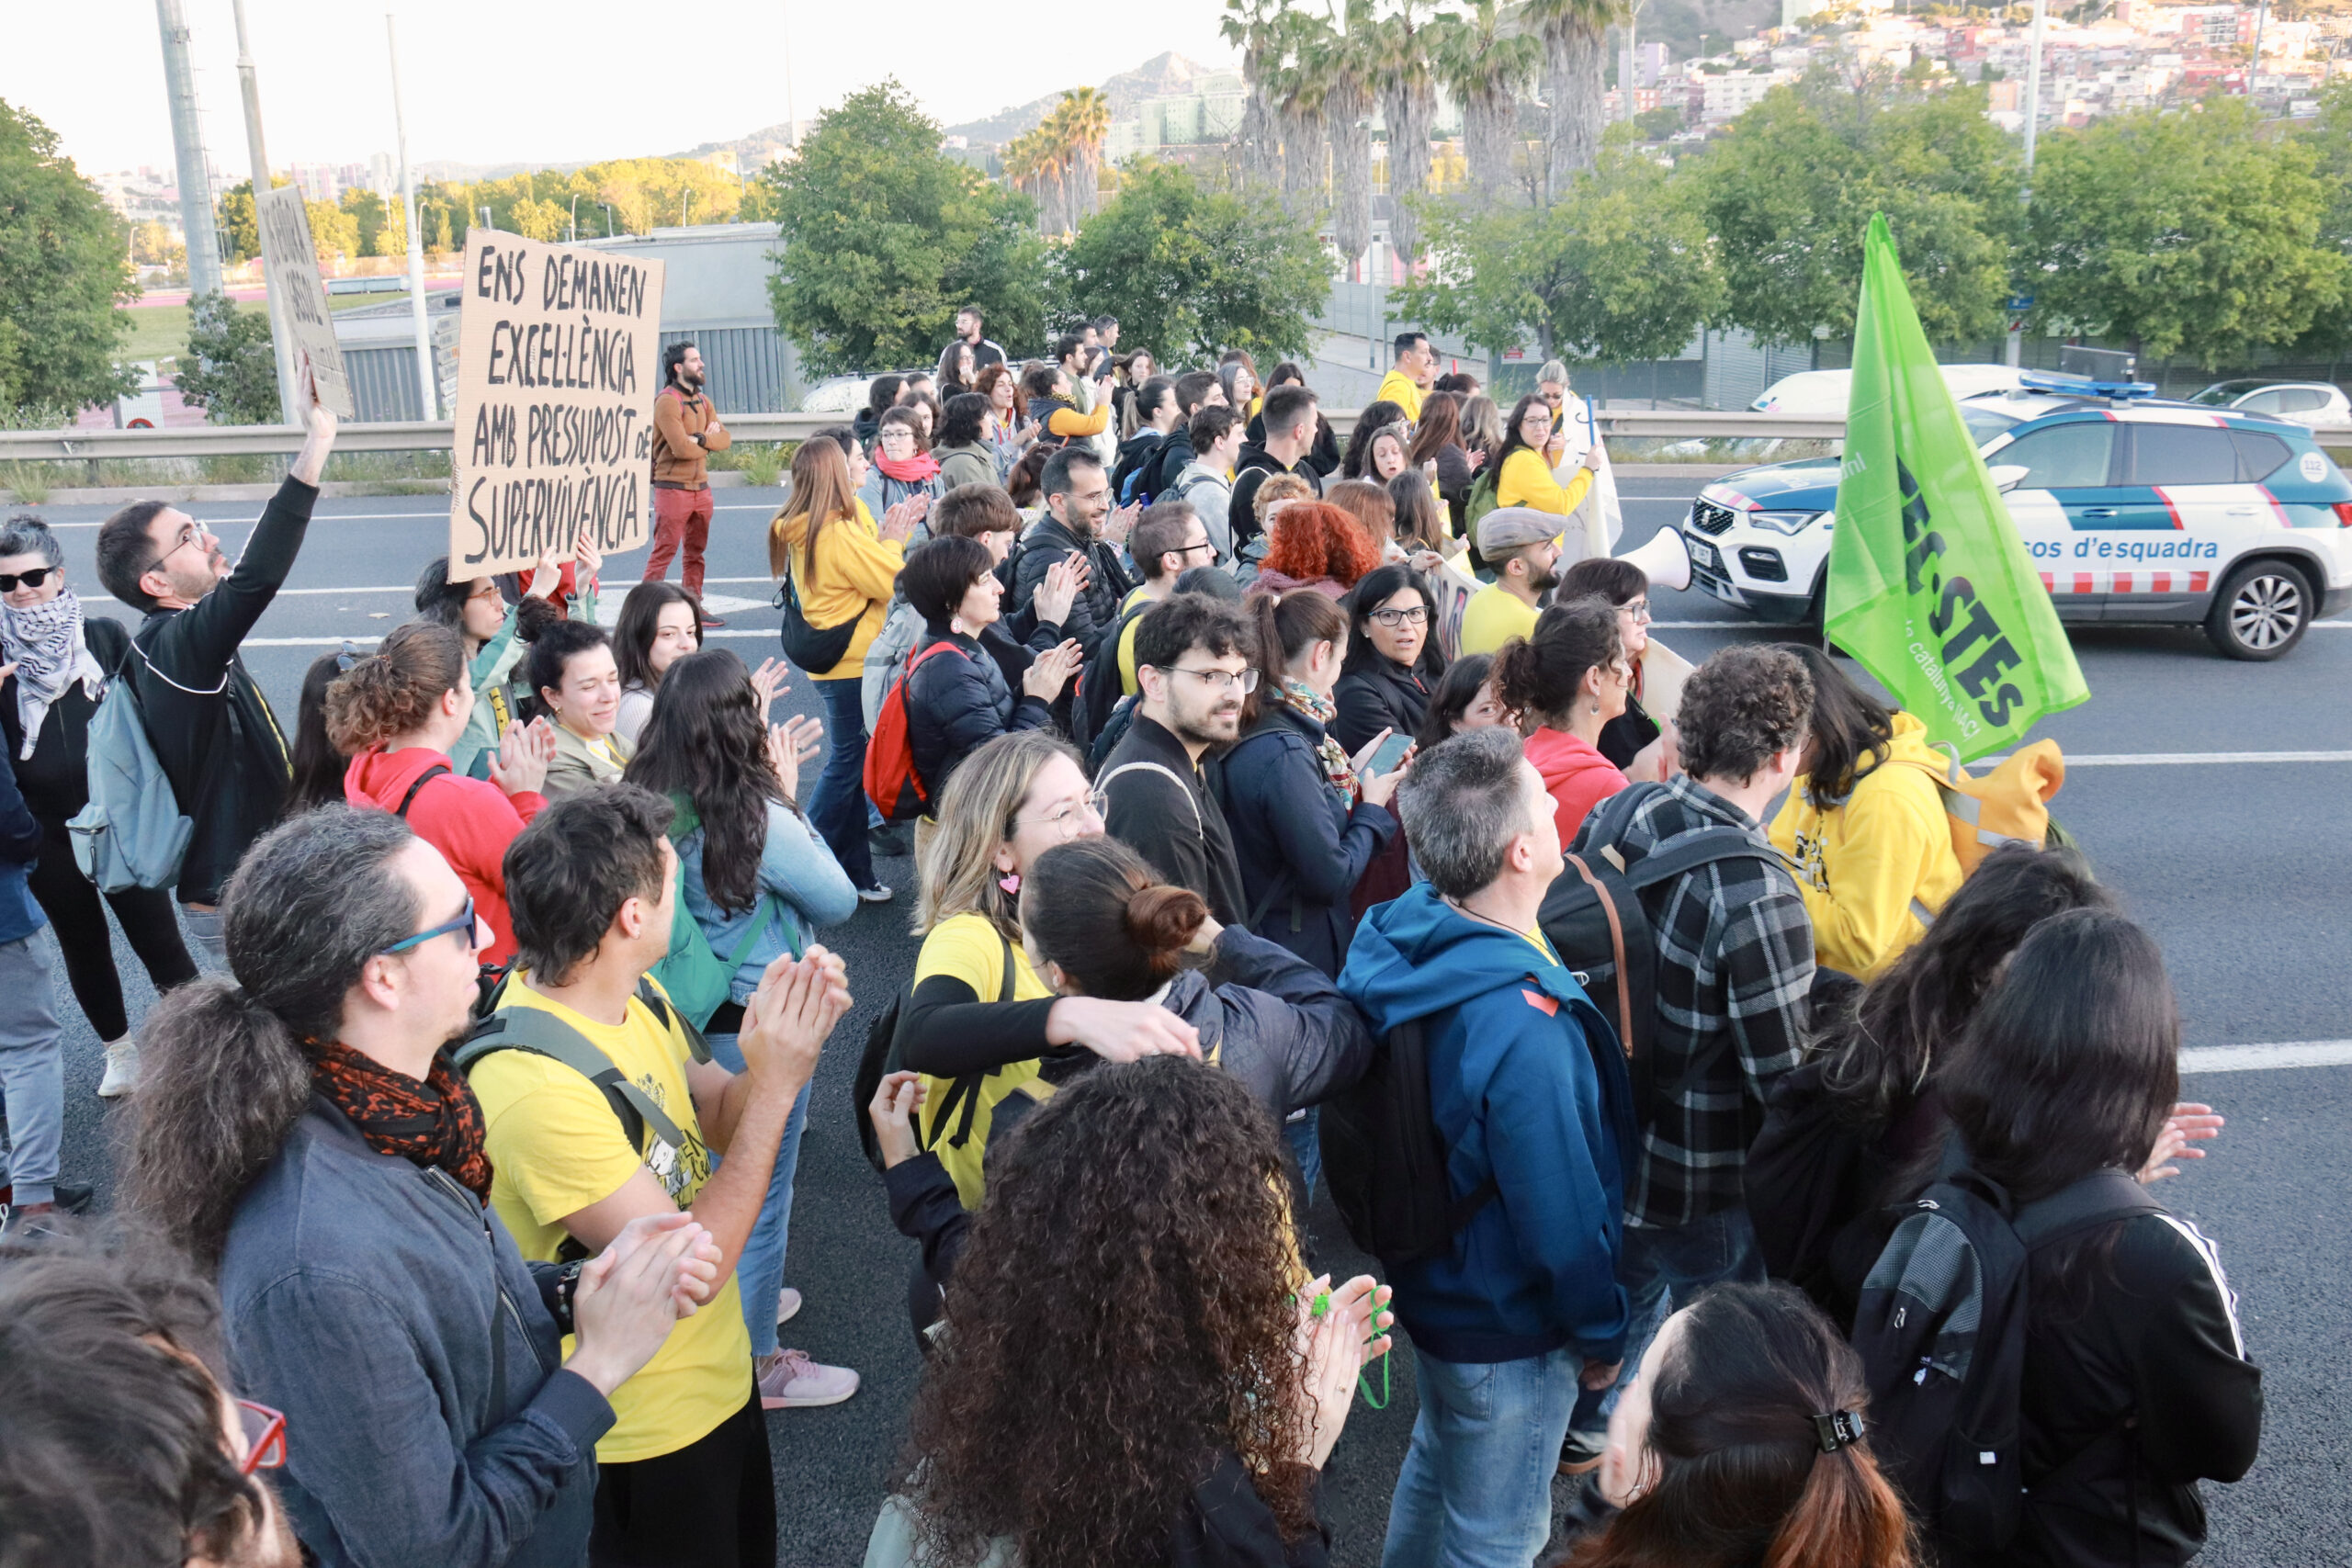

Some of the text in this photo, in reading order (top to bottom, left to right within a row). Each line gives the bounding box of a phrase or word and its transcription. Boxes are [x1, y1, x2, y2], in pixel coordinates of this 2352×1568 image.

[478, 245, 647, 319] ENS DEMANEN
[471, 401, 651, 469] AMB PRESSUPOST DE
